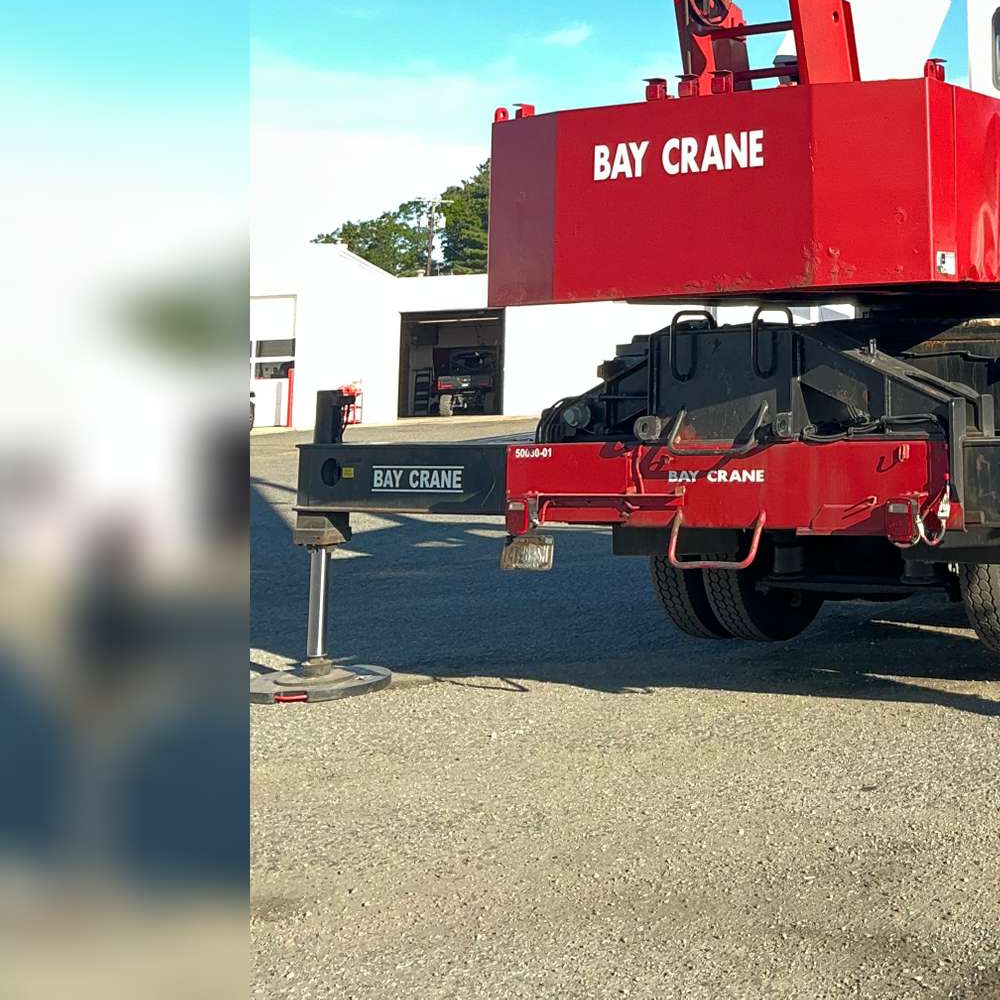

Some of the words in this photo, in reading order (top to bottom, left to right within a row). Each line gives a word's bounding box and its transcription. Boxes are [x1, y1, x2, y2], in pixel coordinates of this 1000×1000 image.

[593, 141, 650, 181] BAY
[661, 130, 765, 176] CRANE
[373, 469, 403, 488] BAY
[408, 469, 462, 489] CRANE
[668, 470, 699, 483] BAY
[706, 469, 765, 483] CRANE
